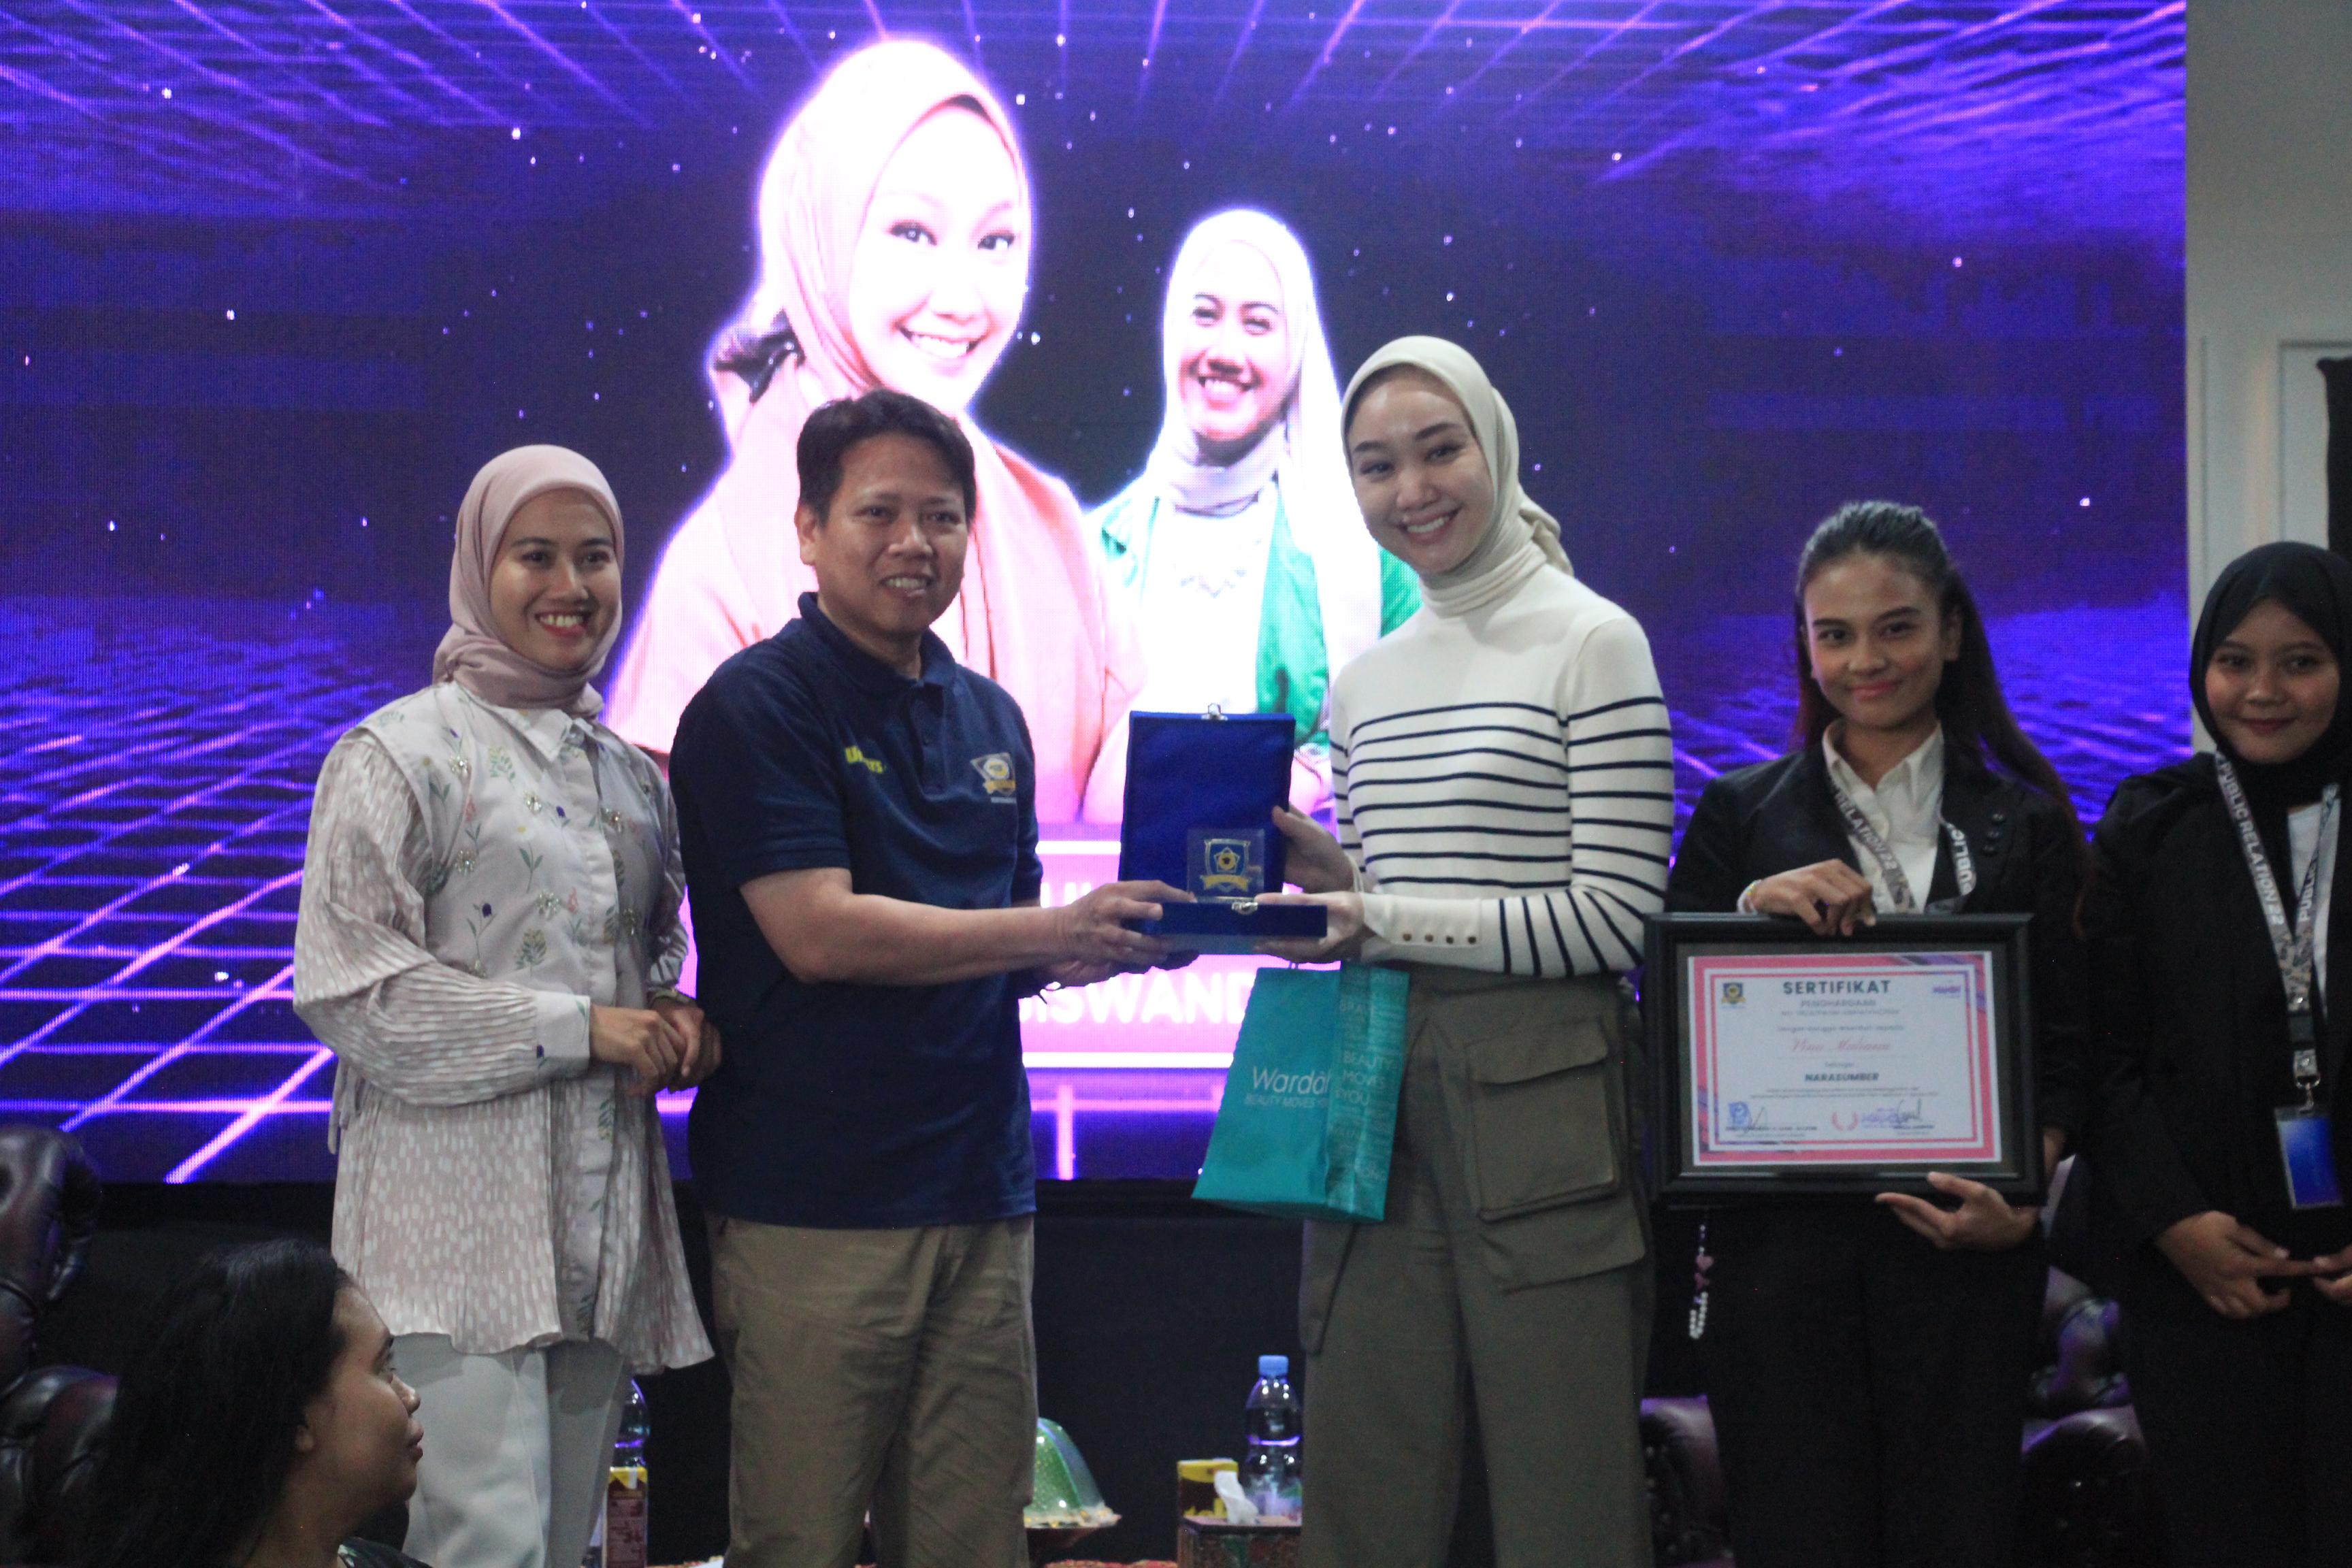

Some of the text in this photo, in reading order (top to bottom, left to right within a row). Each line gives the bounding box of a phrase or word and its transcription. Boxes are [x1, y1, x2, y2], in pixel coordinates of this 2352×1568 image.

[2240, 820, 2277, 902] RELATION
[1782, 979, 1891, 995] SERTIFIKAT
[1805, 1073, 1880, 1081] NARASUMBER
